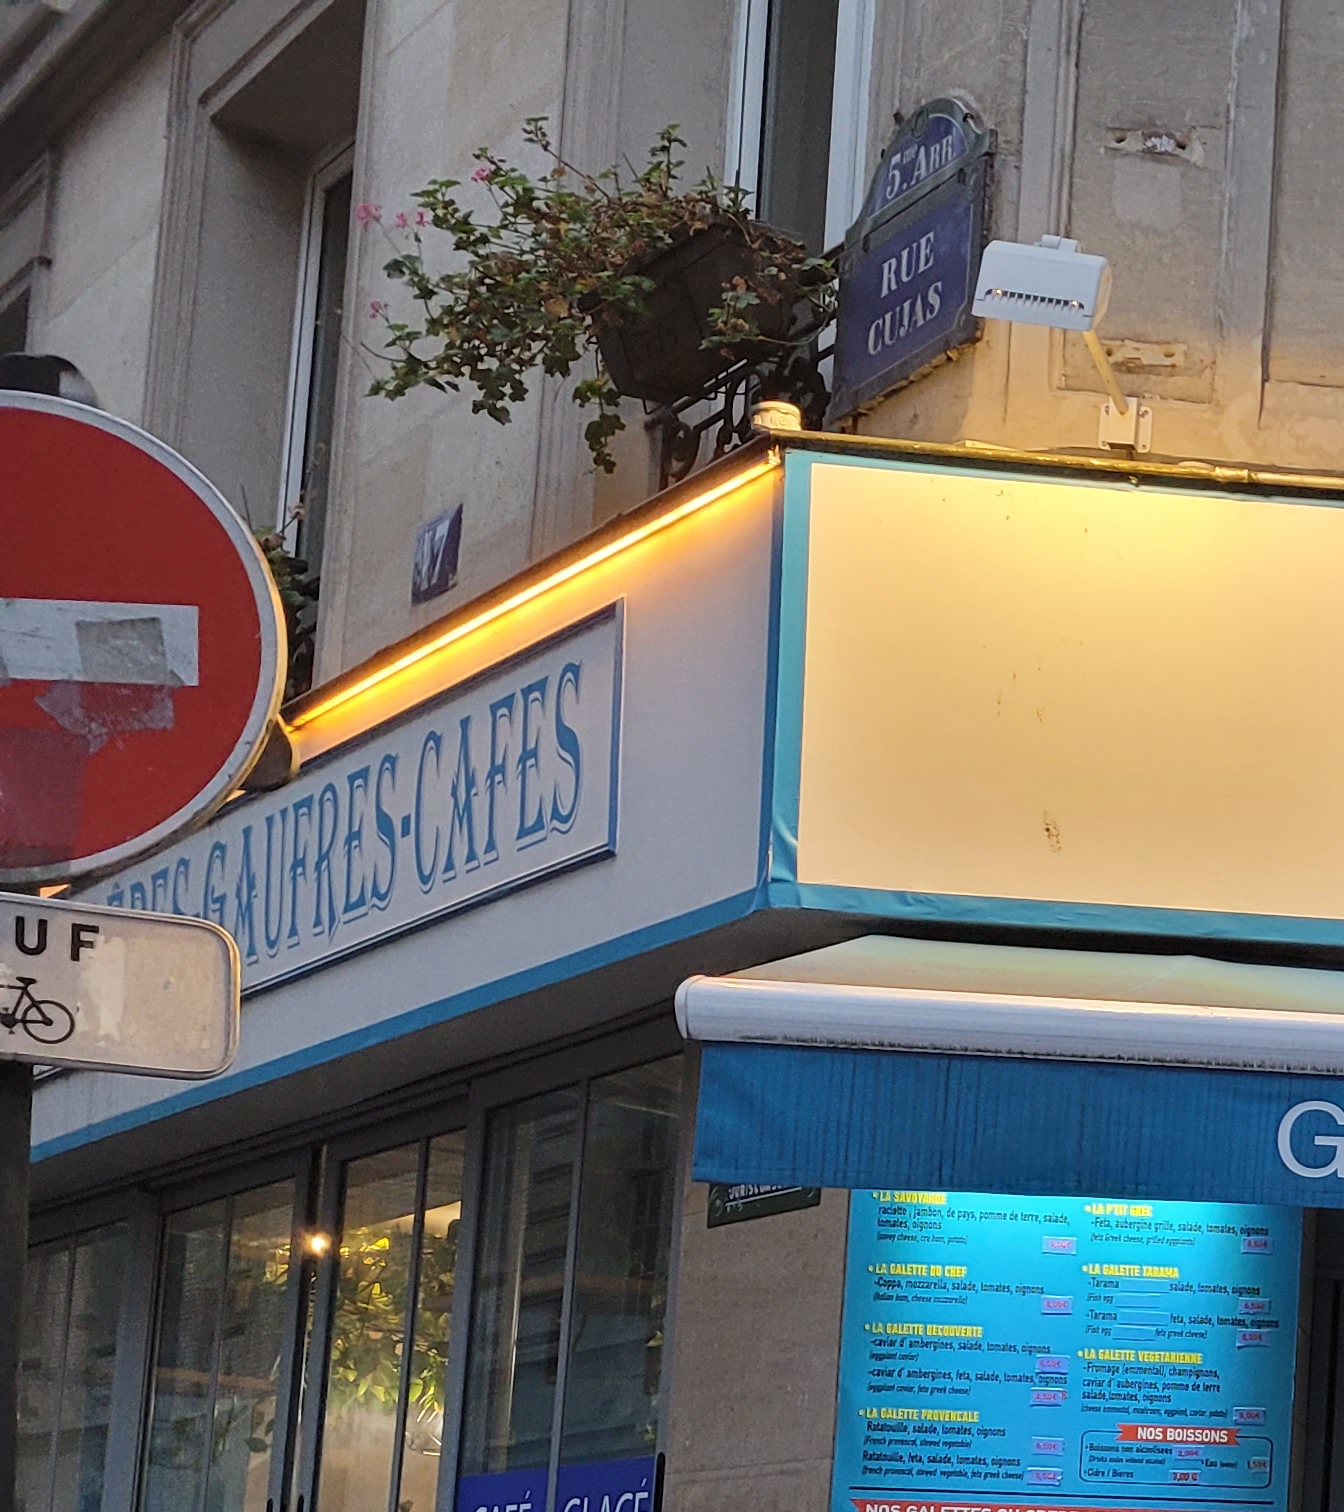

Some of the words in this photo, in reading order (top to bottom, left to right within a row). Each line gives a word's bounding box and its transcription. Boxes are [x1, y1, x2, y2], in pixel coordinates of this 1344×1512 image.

[880, 232, 935, 298] RUE
[868, 282, 942, 356] CUJAS
[1138, 1427, 1163, 1440] NOS
[1167, 1428, 1228, 1442] BOISSONS
